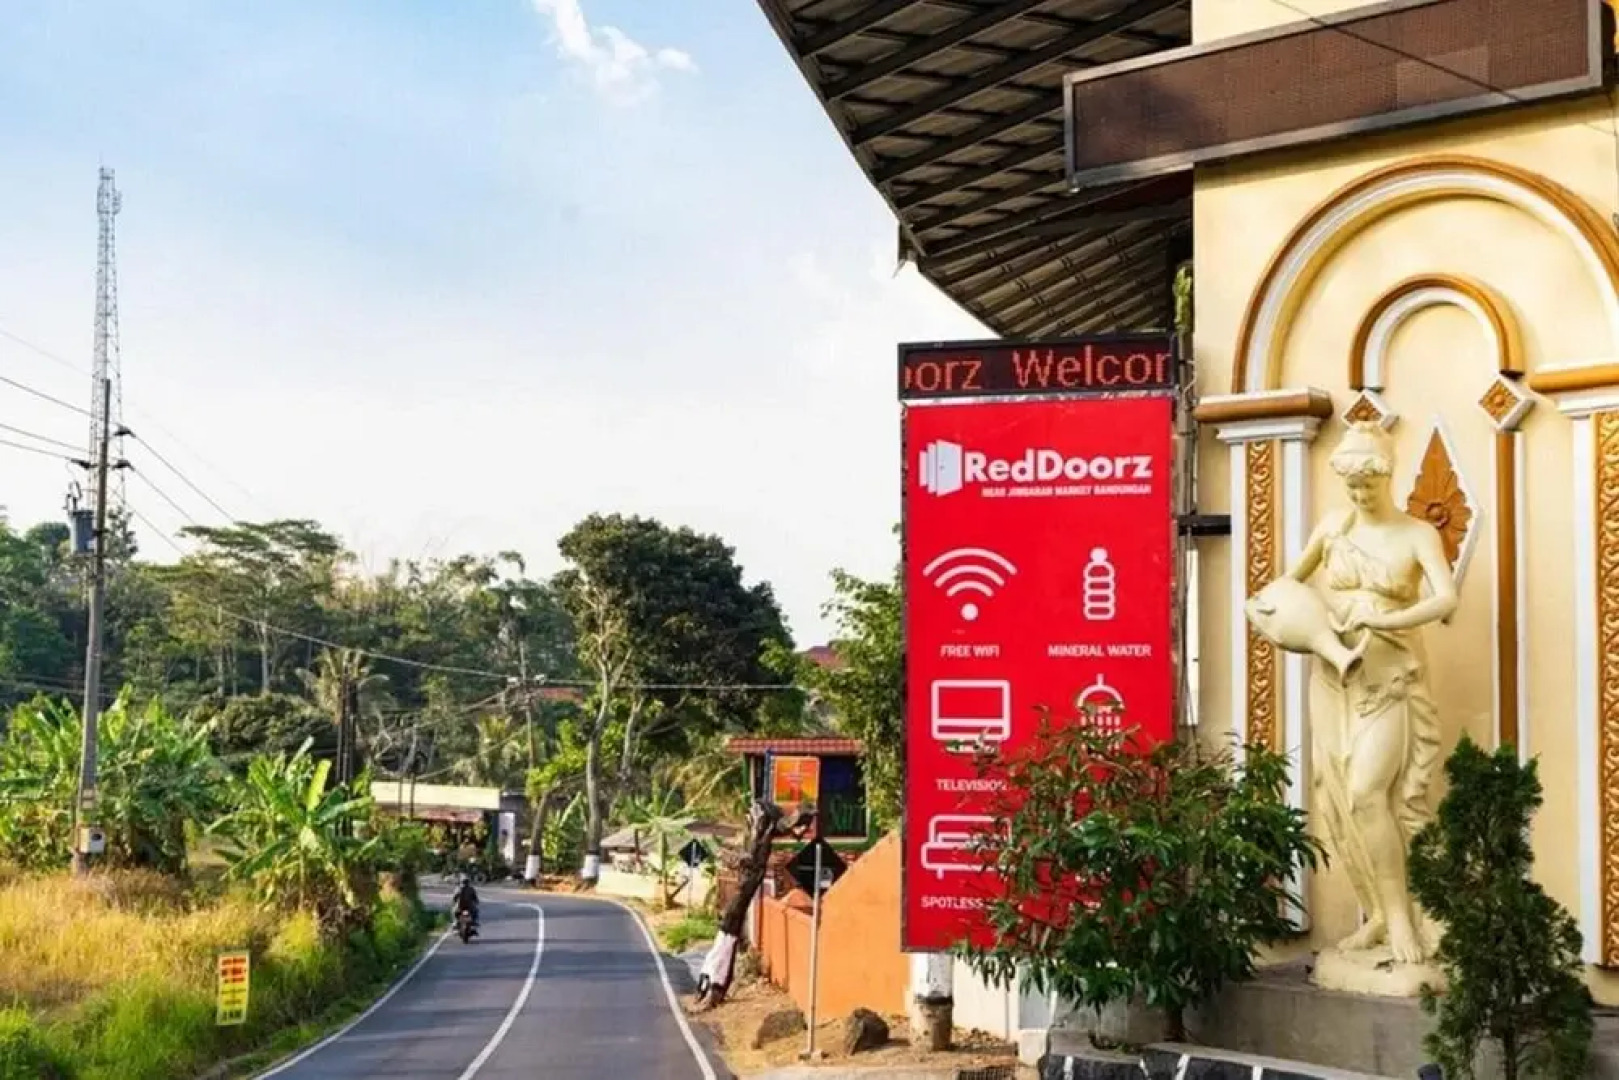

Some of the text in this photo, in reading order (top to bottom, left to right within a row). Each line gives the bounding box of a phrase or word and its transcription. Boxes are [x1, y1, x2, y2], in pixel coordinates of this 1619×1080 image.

[905, 360, 982, 391] orz
[965, 448, 1153, 483] RedDoorz
[941, 644, 1000, 657] FREE WIFI
[1048, 644, 1152, 657] MINERAL WATER
